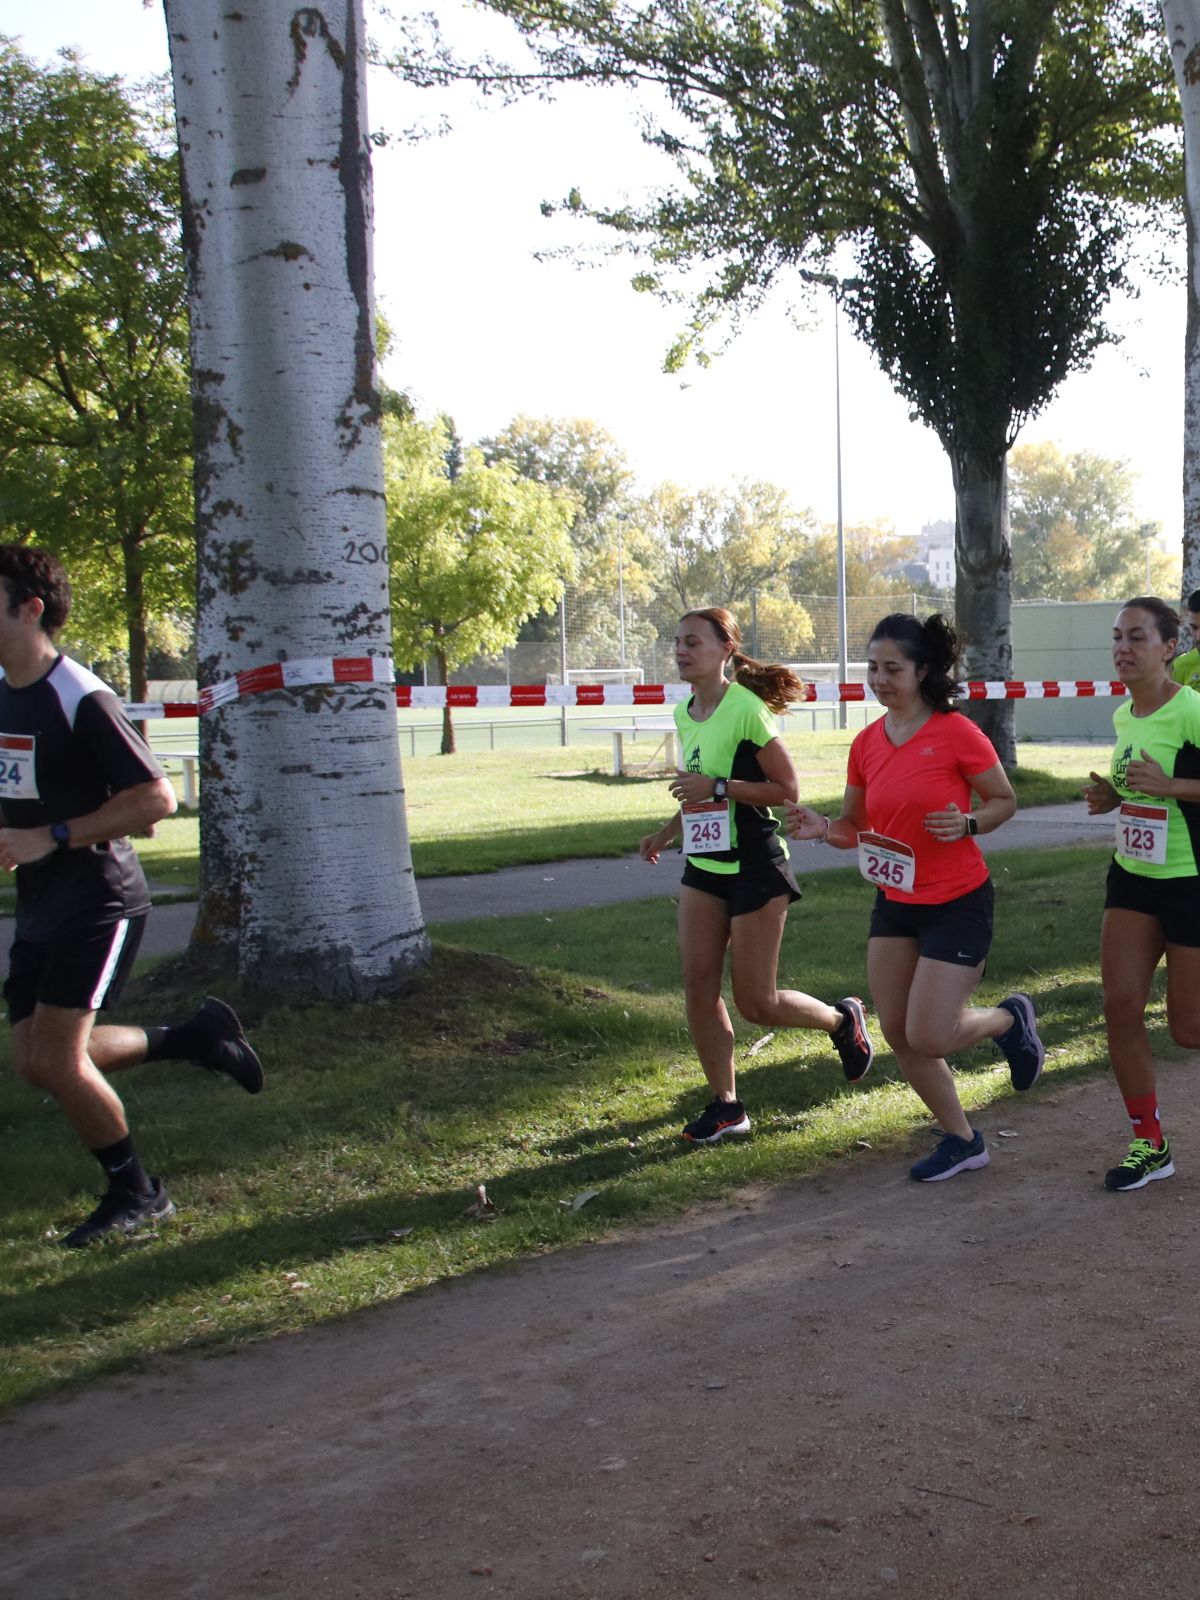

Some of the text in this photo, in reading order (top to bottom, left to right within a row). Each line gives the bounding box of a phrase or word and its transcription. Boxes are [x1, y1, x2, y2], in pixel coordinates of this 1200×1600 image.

[691, 821, 721, 842] 243
[1123, 826, 1154, 850] 123
[867, 856, 905, 884] 245
